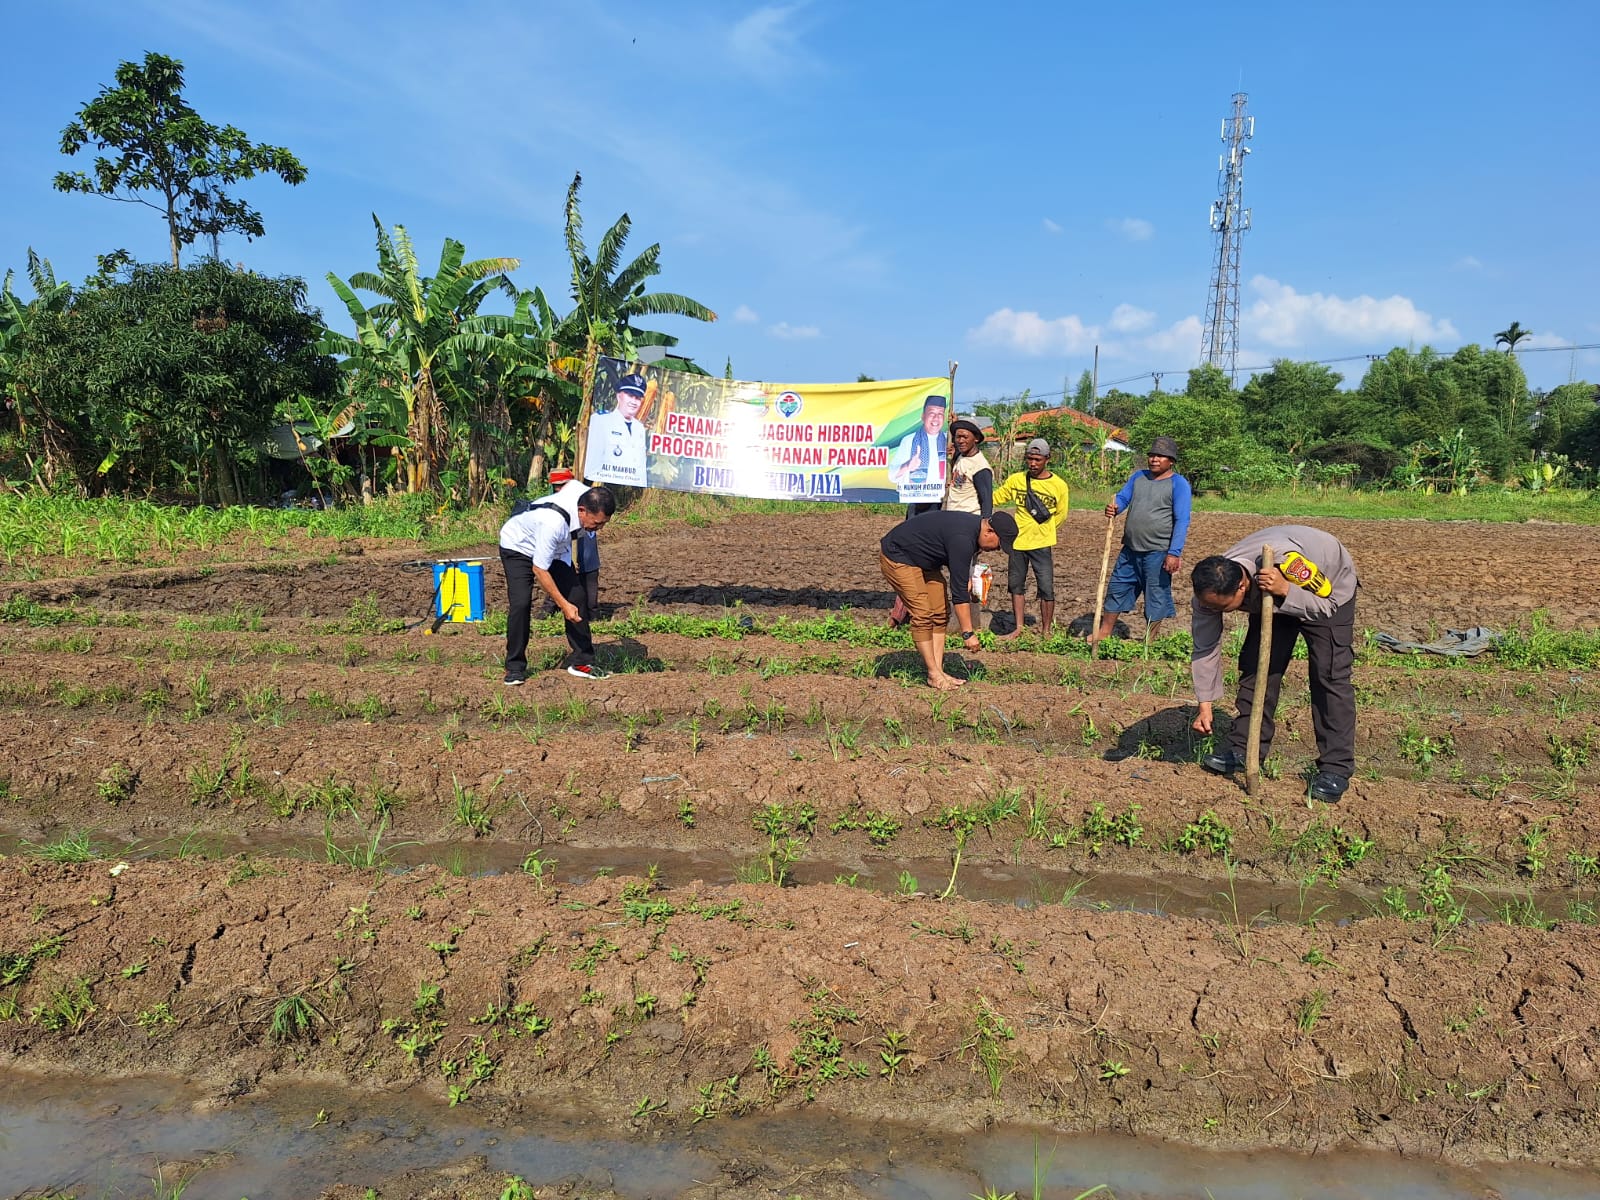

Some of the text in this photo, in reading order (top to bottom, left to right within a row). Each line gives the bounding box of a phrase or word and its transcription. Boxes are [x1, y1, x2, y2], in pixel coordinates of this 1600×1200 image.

[667, 413, 873, 443] PENANA JAGUNG HIBRIDA
[828, 447, 888, 466] PANGAN
[810, 473, 841, 496] JAYA
